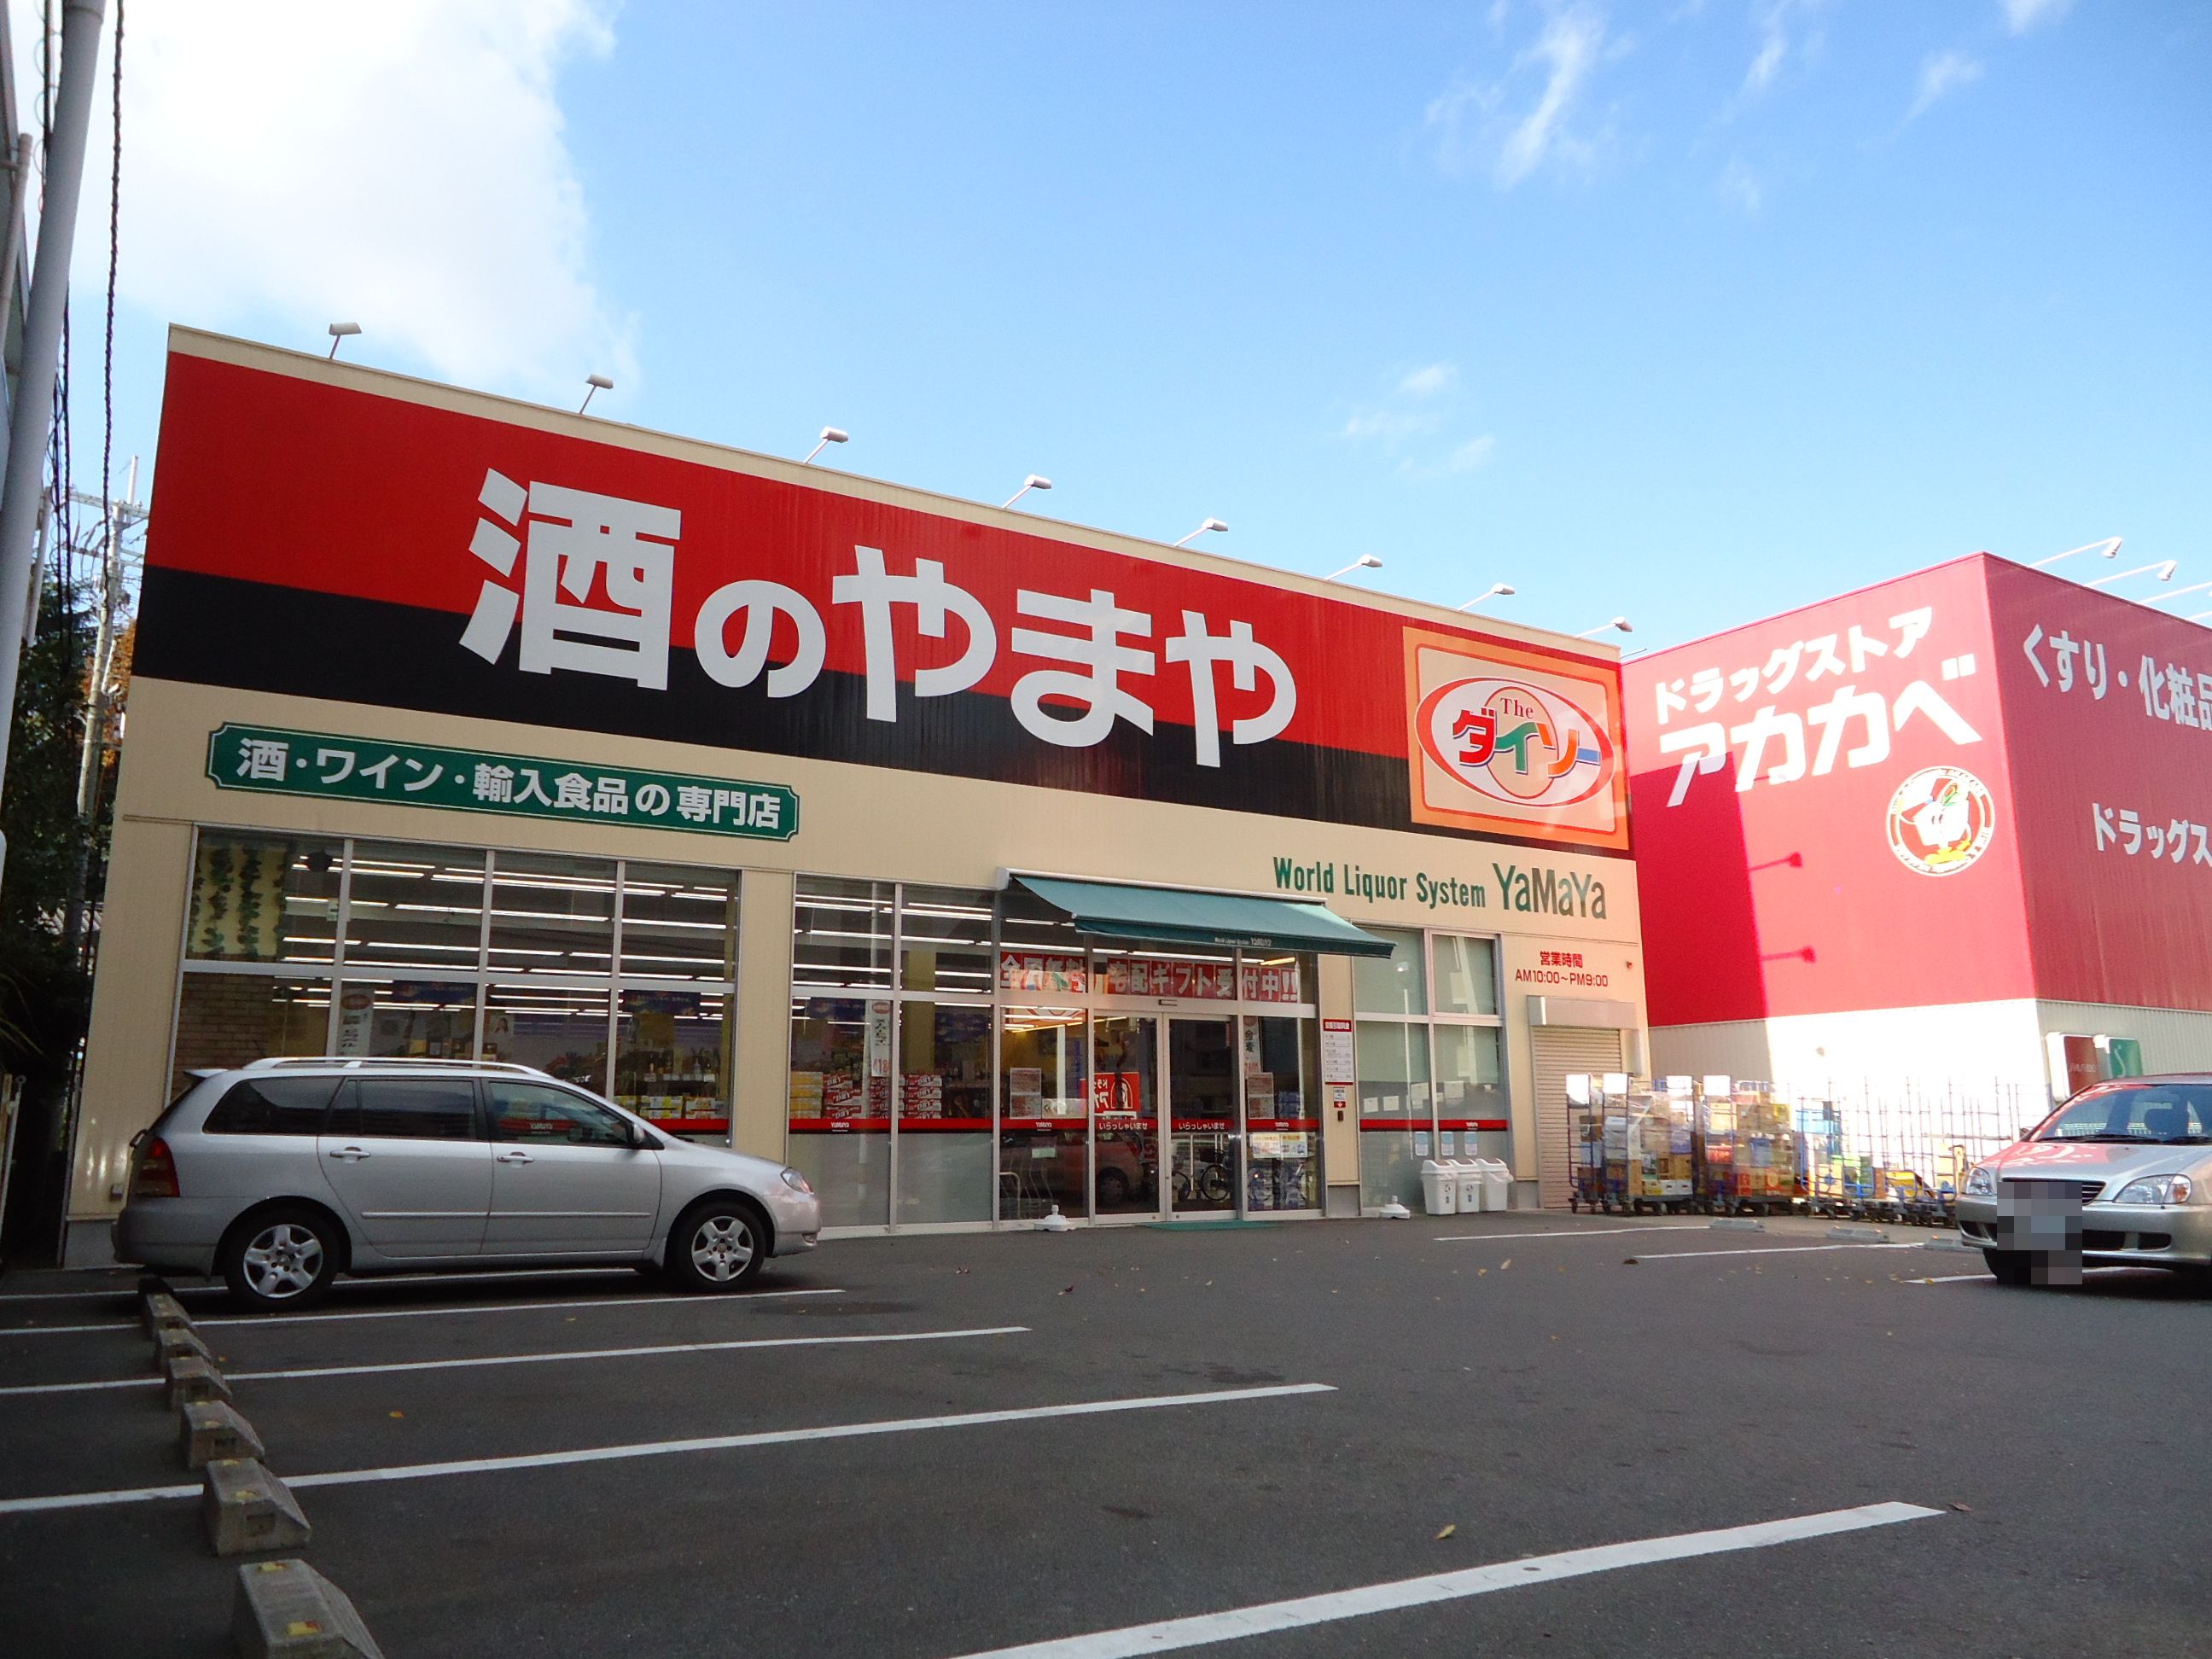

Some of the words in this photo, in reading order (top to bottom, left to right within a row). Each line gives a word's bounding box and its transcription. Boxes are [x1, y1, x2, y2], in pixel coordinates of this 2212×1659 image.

[459, 467, 1297, 767] 酒のやまや
[1656, 606, 1932, 725] ドラッグストア
[1500, 697, 1534, 719] The
[1660, 654, 1983, 807] アカカベ
[236, 737, 781, 829] 酒・ワイン・輸入食品の専門店
[2093, 803, 2212, 867] ドラッグス
[1273, 857, 1334, 894] World
[1344, 864, 1407, 903] Liquor
[1416, 872, 1486, 909] System
[1492, 863, 1607, 920] YaMaYa
[1540, 951, 1583, 968] 営業時間
[1098, 1122, 1148, 1131] いらっしゃいませ
[1179, 1121, 1225, 1131] いらっしゃいませ
